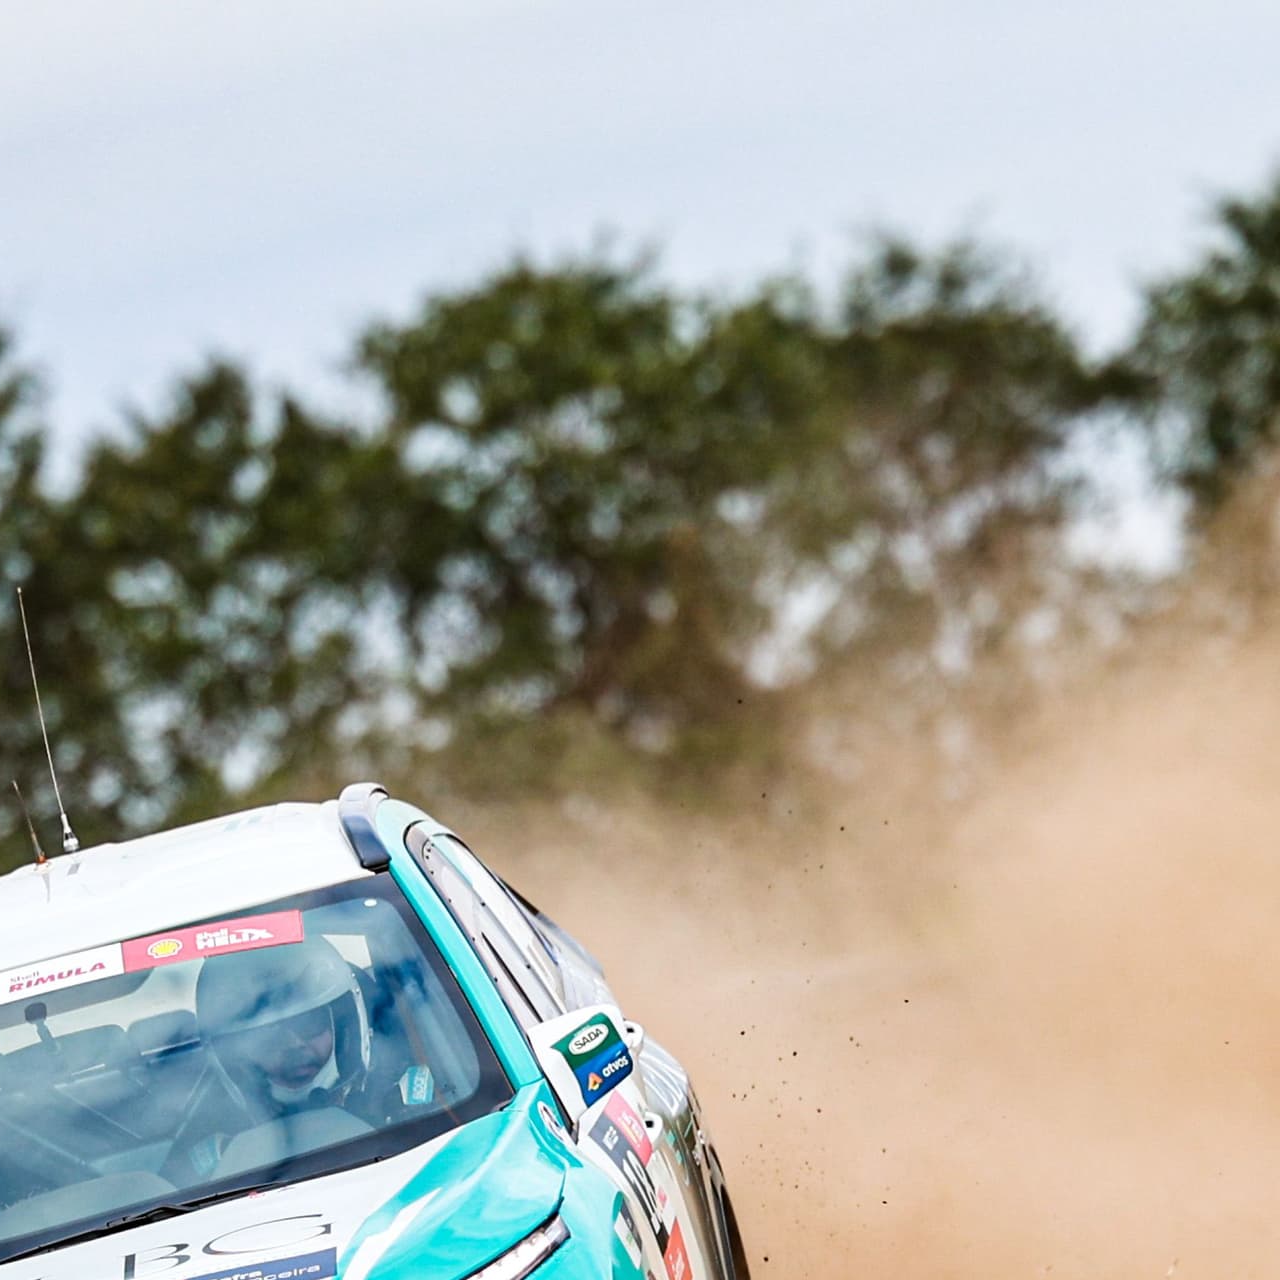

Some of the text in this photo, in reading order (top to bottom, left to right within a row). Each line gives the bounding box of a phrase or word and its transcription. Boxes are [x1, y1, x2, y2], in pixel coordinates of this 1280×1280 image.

[196, 928, 230, 943] Shell
[196, 928, 275, 951] HELIX
[8, 962, 107, 994] RIMULA
[574, 1027, 604, 1050] SADA
[602, 1055, 630, 1077] atvos
